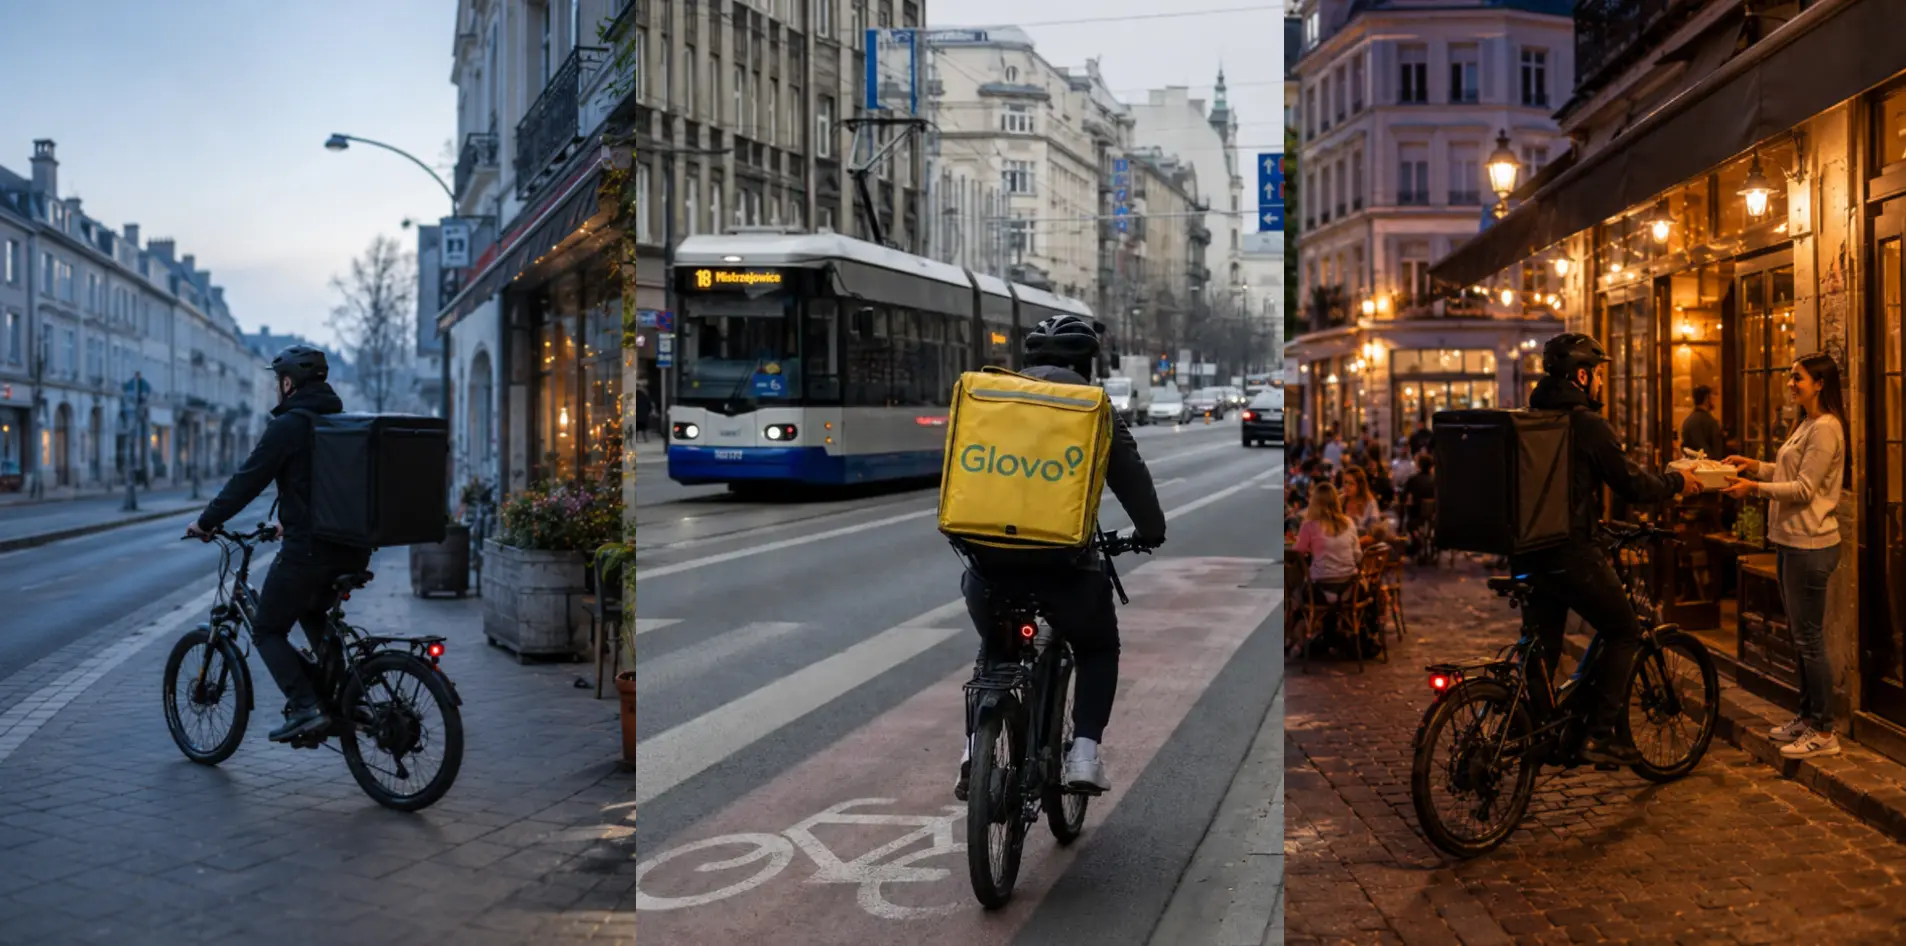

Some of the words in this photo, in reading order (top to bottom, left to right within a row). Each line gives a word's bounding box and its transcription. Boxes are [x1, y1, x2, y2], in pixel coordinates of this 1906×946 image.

[695, 269, 712, 288] 18
[715, 271, 781, 285] Mistrzejowice
[961, 444, 1064, 482] Glovo
